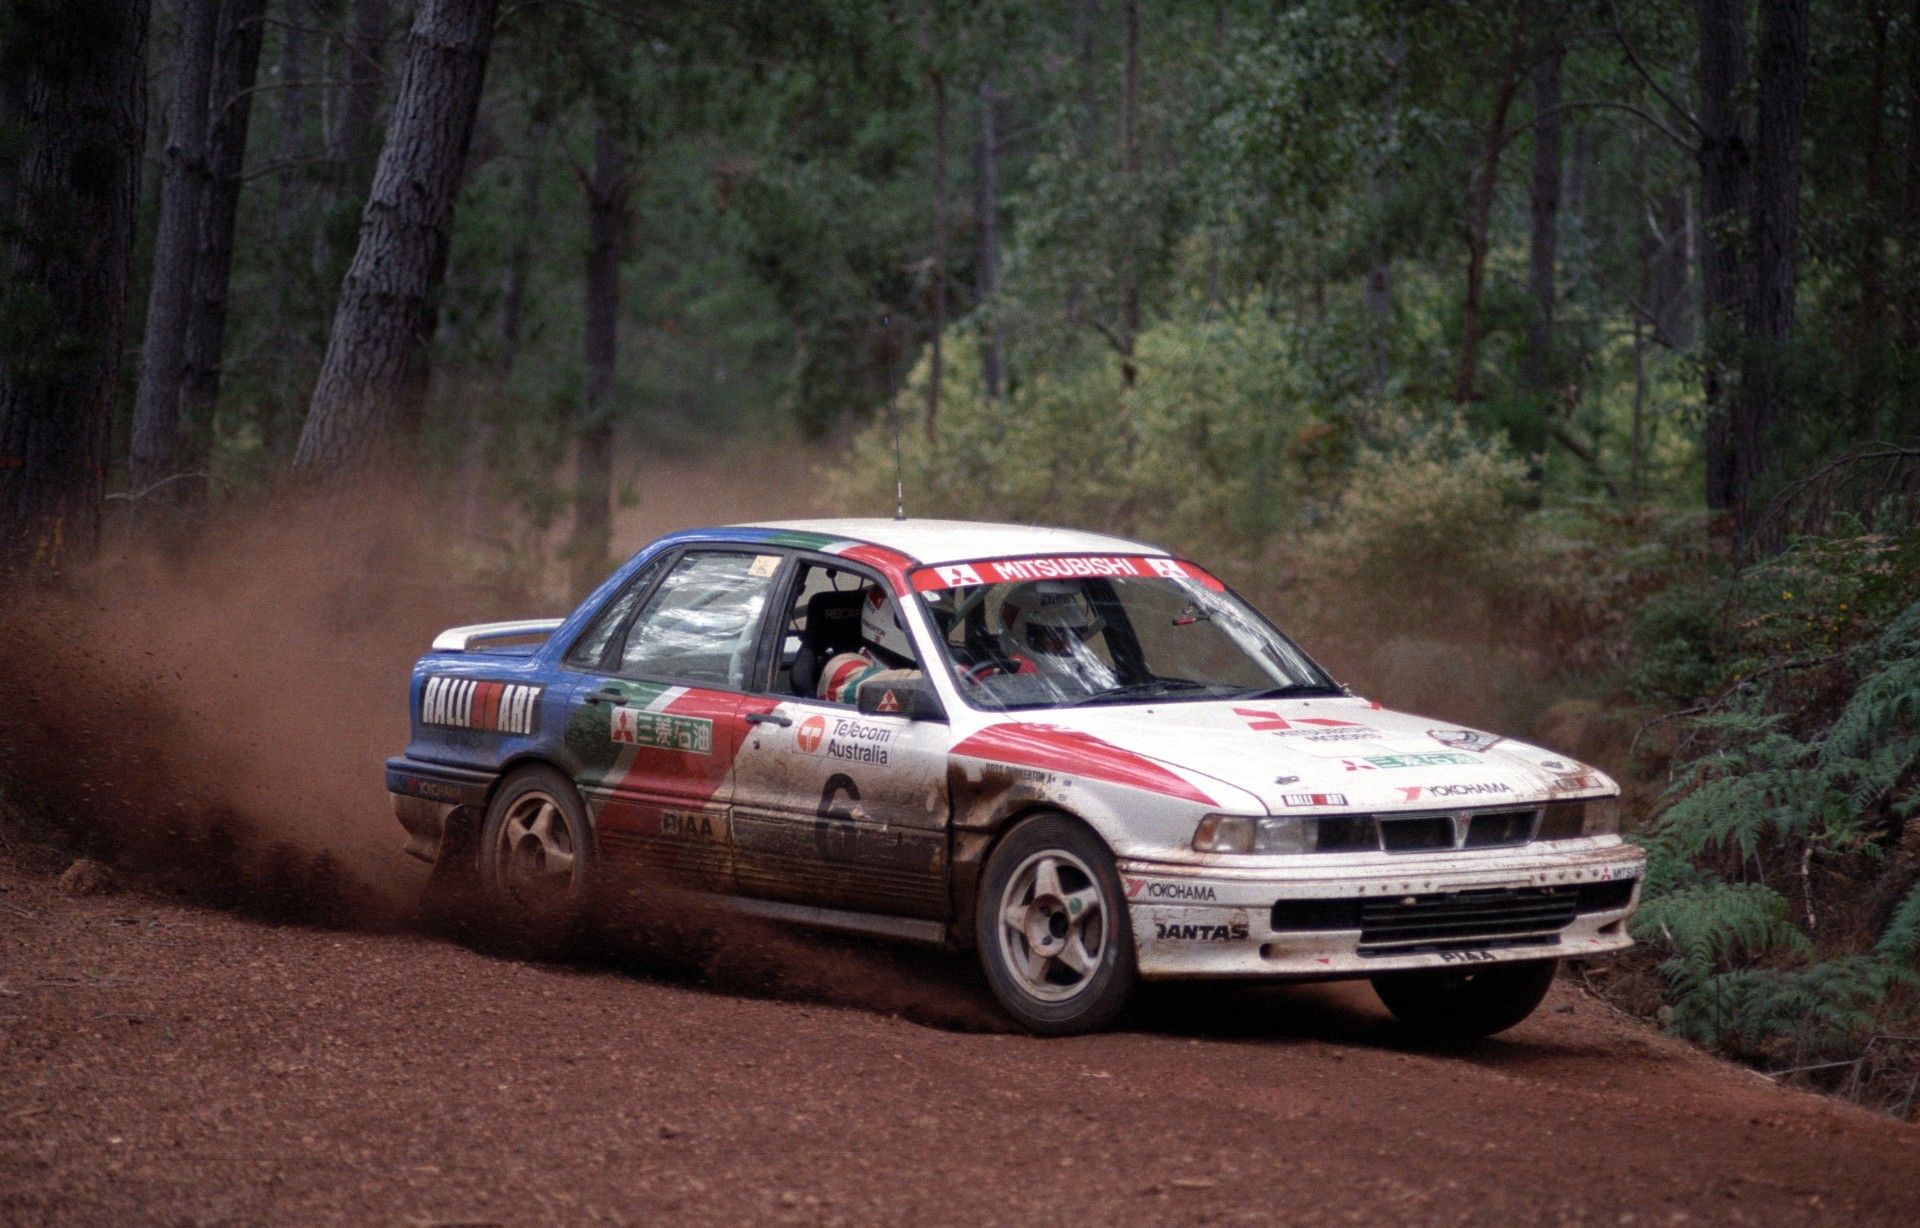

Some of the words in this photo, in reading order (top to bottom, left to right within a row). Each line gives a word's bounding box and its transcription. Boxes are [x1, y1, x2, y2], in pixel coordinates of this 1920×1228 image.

[991, 557, 1139, 580] MITSUBISHI
[423, 676, 478, 727] RALLI
[498, 684, 541, 734] ART
[638, 714, 711, 752] 三菱石油
[832, 718, 892, 743] Telecom
[827, 738, 888, 766] Australia
[1423, 783, 1514, 797] YOKOHAMA
[815, 773, 861, 862] 6
[1146, 882, 1217, 901] YOKOHAMA
[1440, 950, 1497, 962] PIAA
